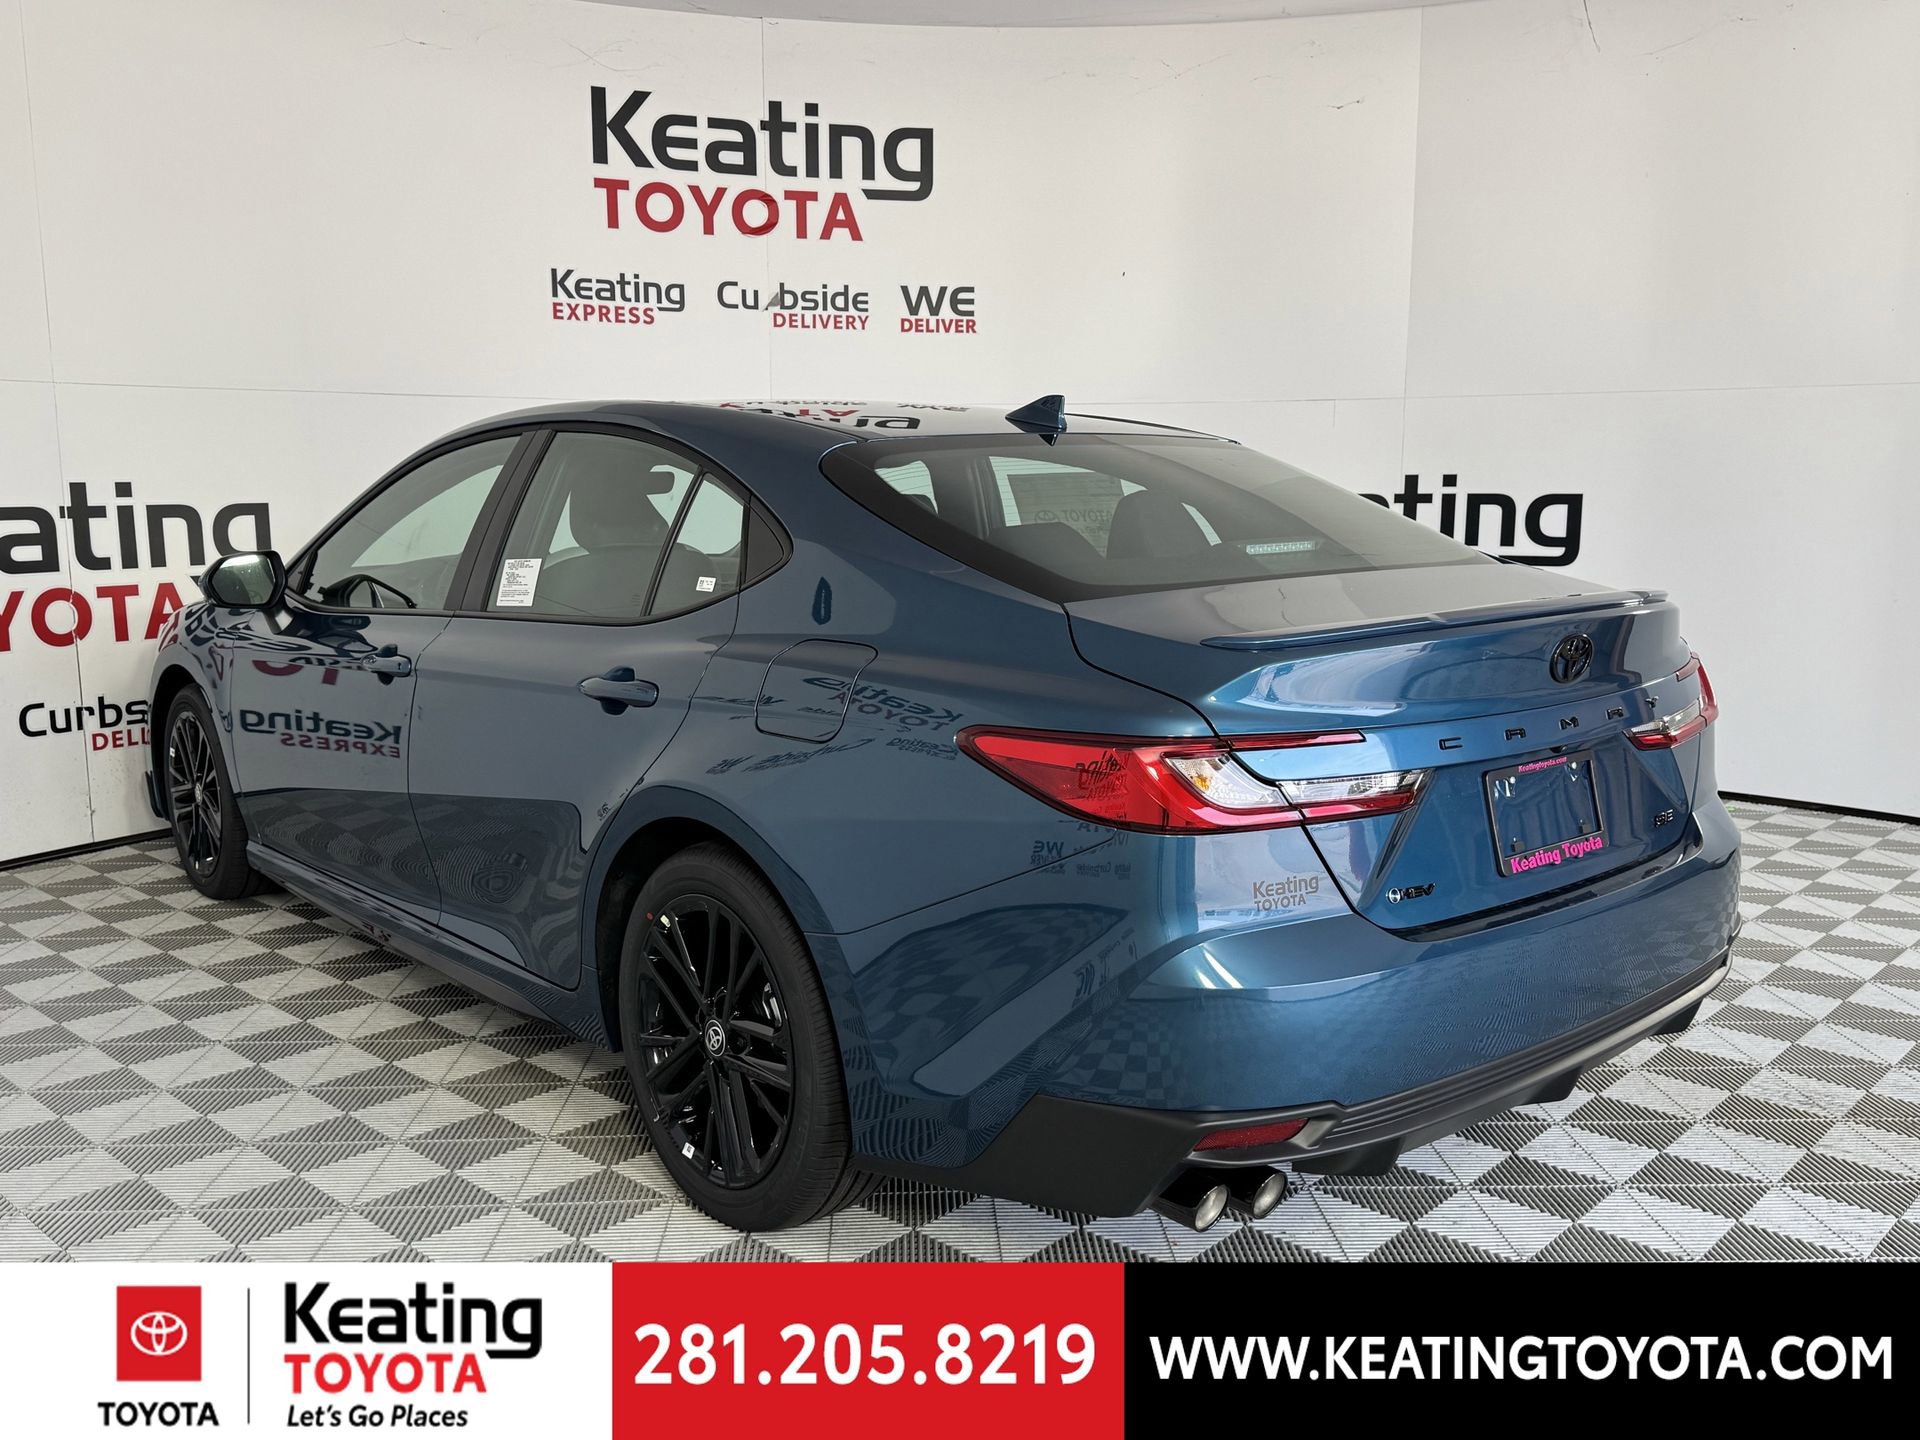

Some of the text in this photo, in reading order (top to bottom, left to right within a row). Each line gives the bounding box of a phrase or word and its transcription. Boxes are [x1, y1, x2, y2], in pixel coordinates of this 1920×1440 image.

[590, 86, 934, 202] Keating
[593, 177, 863, 241] TOYOTA
[550, 267, 685, 312] Keating
[717, 280, 869, 312] Cubside
[900, 285, 975, 317] WE
[552, 302, 655, 325] EXPRESS
[772, 312, 869, 330] DELIVERY
[900, 317, 977, 334] DELIVER
[1358, 474, 1583, 566] ting
[1654, 809, 1674, 828] SE
[1510, 836, 1603, 874] Keating Toyota
[1253, 876, 1319, 899] Keating
[1254, 894, 1307, 912] TOYOTA
